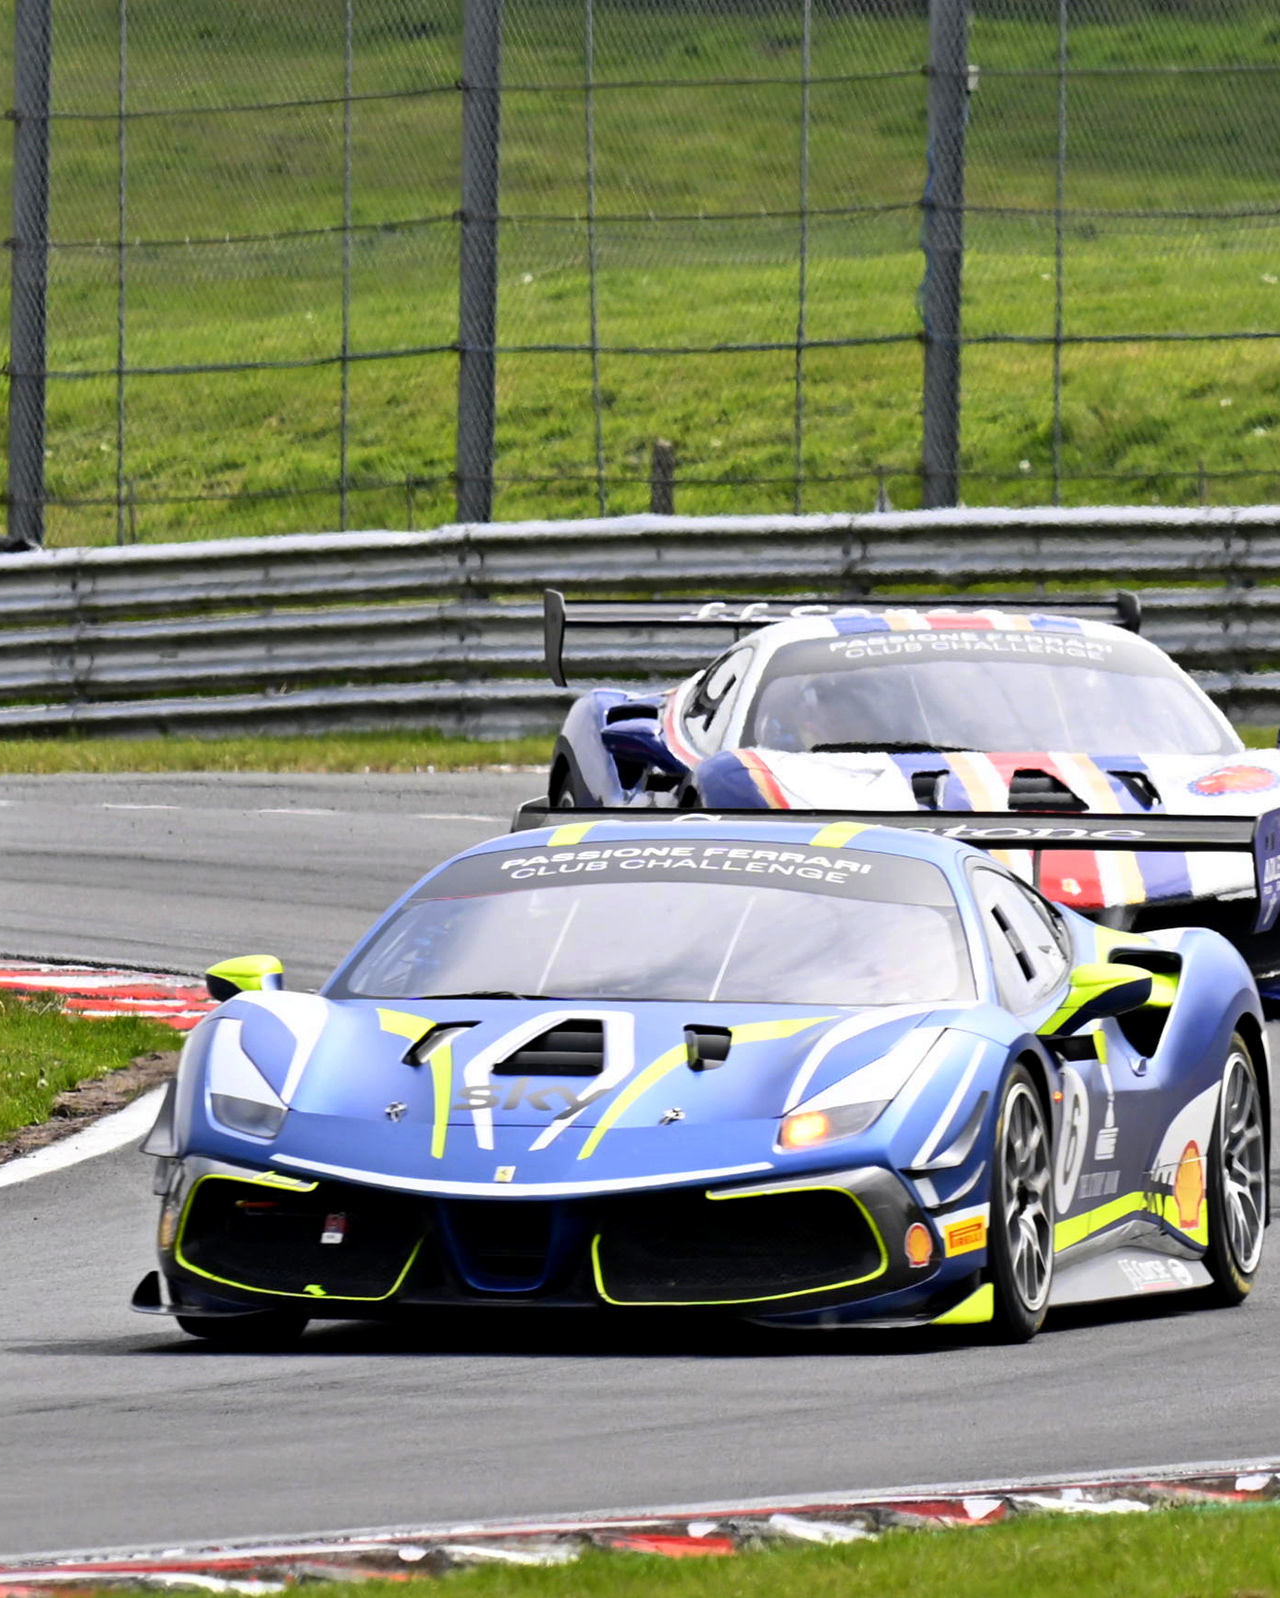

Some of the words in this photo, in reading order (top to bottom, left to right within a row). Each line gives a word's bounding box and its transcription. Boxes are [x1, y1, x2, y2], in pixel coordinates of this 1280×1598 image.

[829, 632, 978, 651] PASSIONE
[986, 634, 1113, 654] FERRARI
[844, 641, 923, 659] CLUB
[931, 640, 1105, 661] CHALLENGE
[500, 846, 696, 871] PASSIONE
[703, 847, 873, 874] FERRARI
[510, 860, 608, 880] CLUB
[620, 858, 847, 884] CHALLENGE
[452, 1077, 615, 1120] sky
[1062, 1092, 1082, 1187] 6
[949, 1222, 983, 1250] PIRELLI
